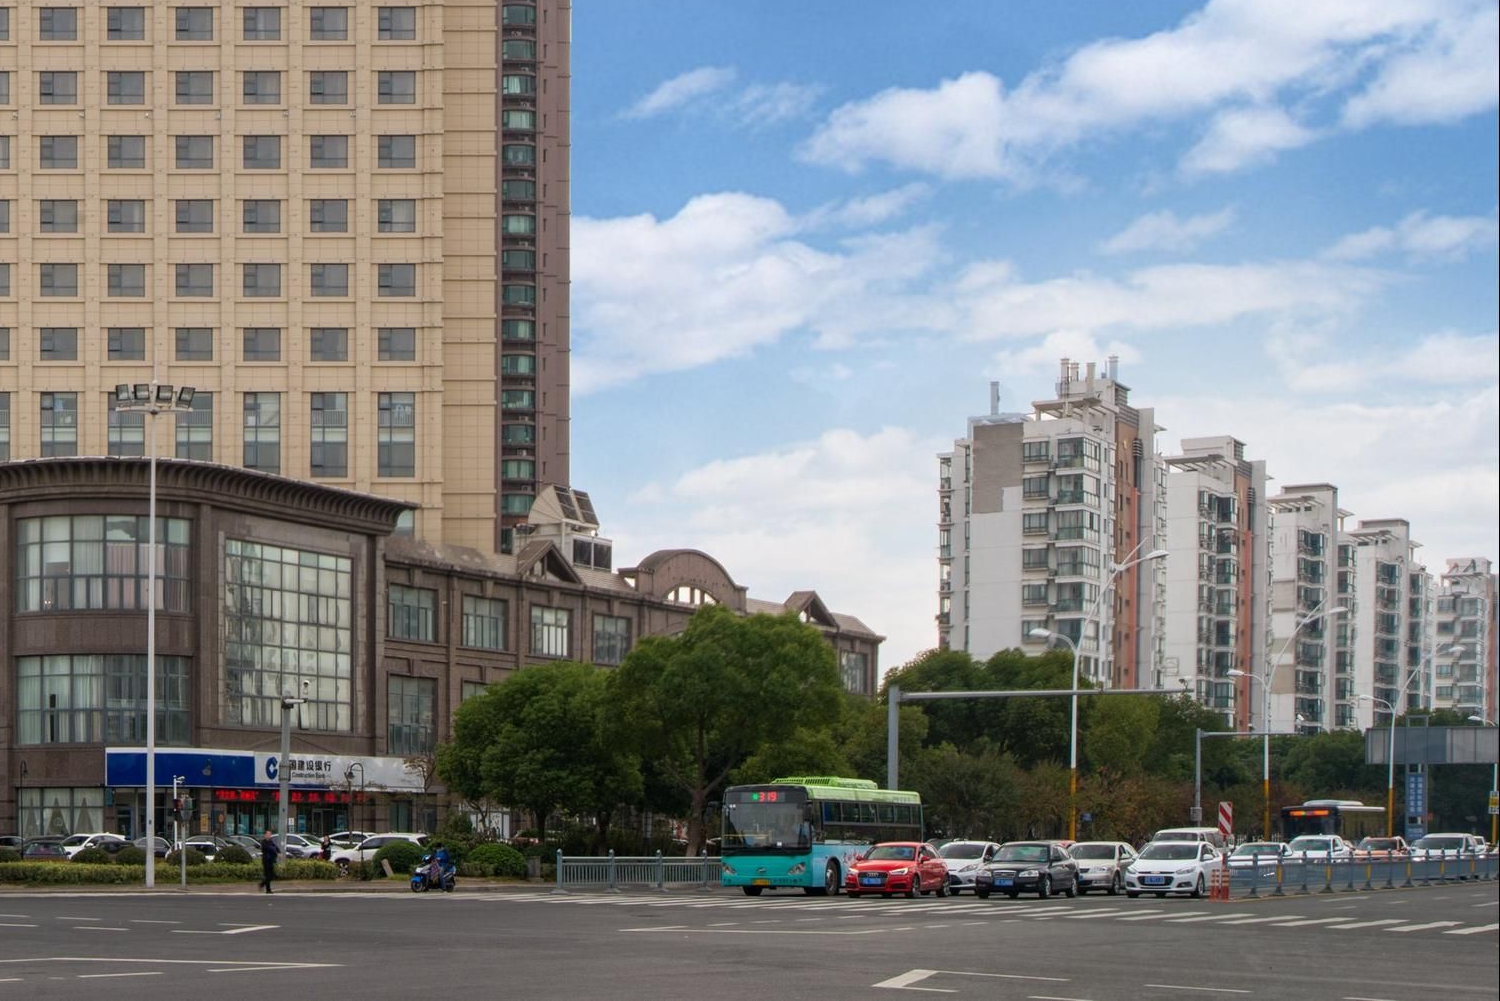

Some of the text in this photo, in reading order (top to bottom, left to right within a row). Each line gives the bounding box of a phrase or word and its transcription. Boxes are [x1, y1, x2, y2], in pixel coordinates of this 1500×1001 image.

[289, 759, 332, 772] 国建设银行
